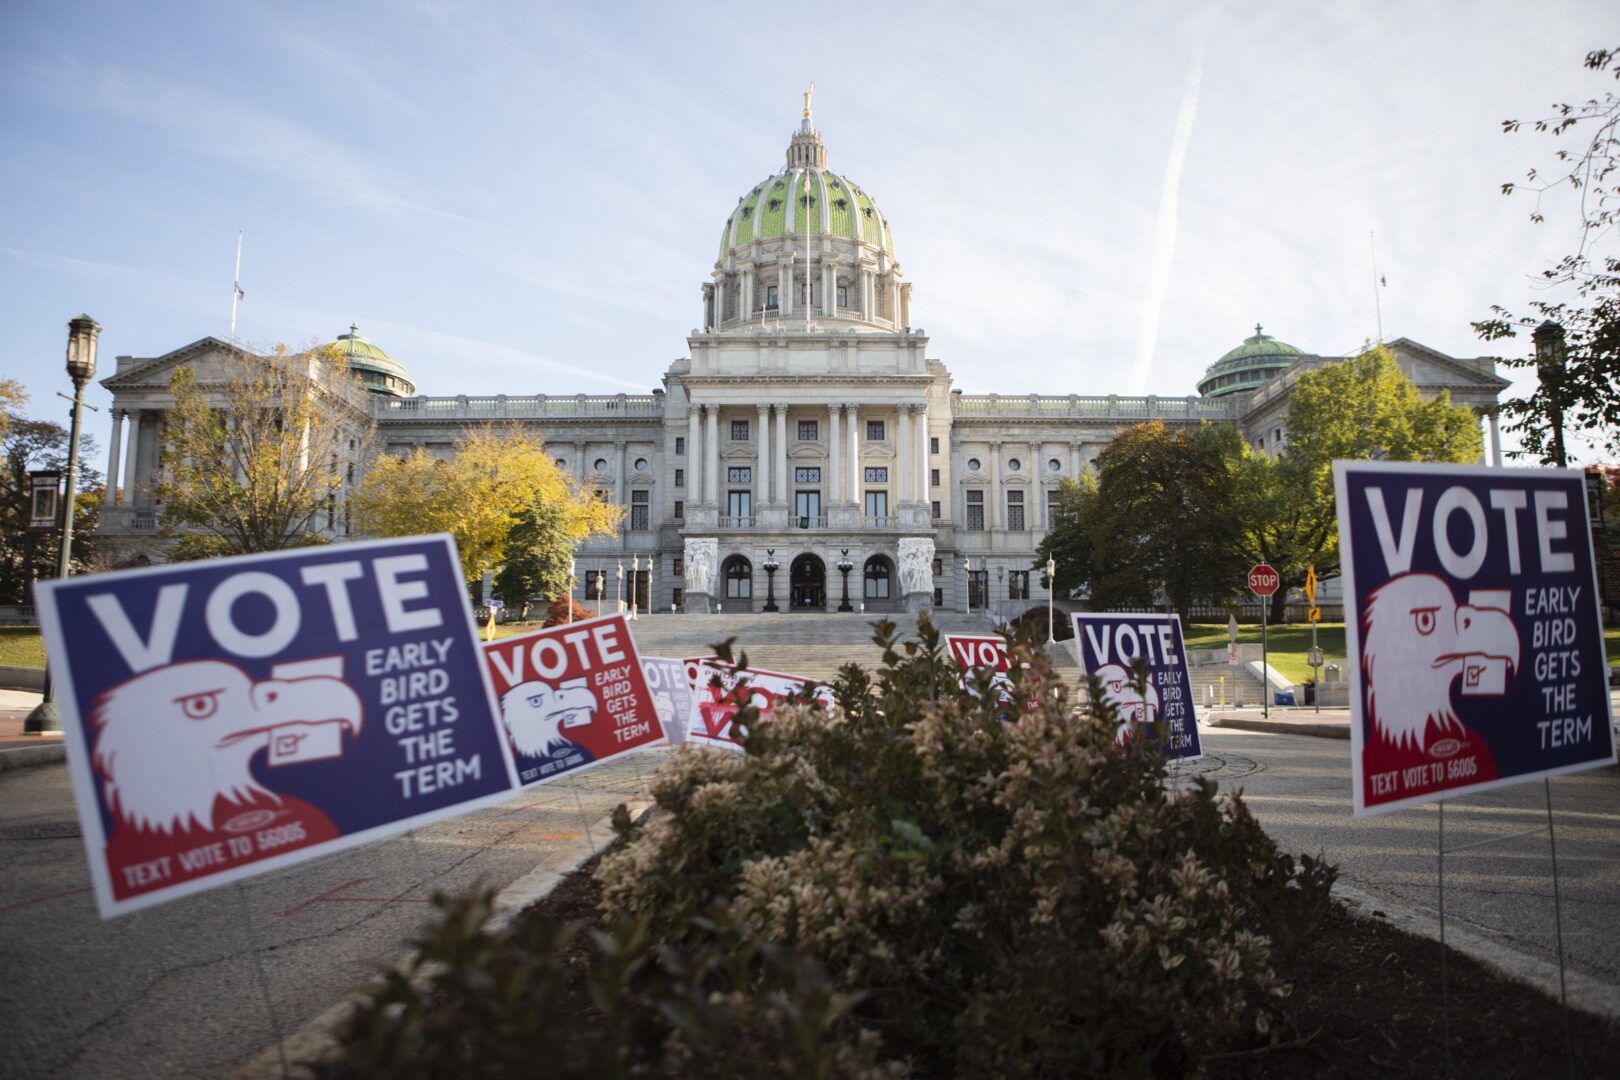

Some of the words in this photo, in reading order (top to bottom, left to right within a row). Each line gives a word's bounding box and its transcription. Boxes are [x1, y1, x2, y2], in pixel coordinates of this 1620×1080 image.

[1364, 486, 1575, 579] VOTE
[1250, 574, 1277, 587] STOP
[86, 554, 443, 673] VOTE
[1525, 586, 1581, 615] EARLY
[1085, 624, 1178, 667] VOTE
[1533, 618, 1576, 648] BIRD
[365, 638, 454, 676] EARLY
[488, 624, 626, 686] VOTE
[955, 642, 1018, 669] VOT
[1534, 650, 1581, 681] GETS
[380, 668, 450, 706] BIRD
[595, 665, 631, 686] EARLY
[602, 681, 631, 699] BIRD
[385, 697, 459, 735] GETS
[606, 694, 637, 714] GETS
[1542, 684, 1577, 714] THE
[613, 710, 637, 727] THE
[613, 721, 650, 743] TERM
[1537, 715, 1592, 749] TERM
[398, 728, 455, 764] THE
[394, 754, 482, 799] TERM
[1370, 770, 1398, 796] TEXT
[1403, 764, 1429, 790] VOTE
[1430, 762, 1444, 782] TO
[1447, 756, 1477, 779] 56005
[123, 857, 172, 888] TEXT
[178, 842, 226, 872] VOTE
[228, 836, 252, 859] TO
